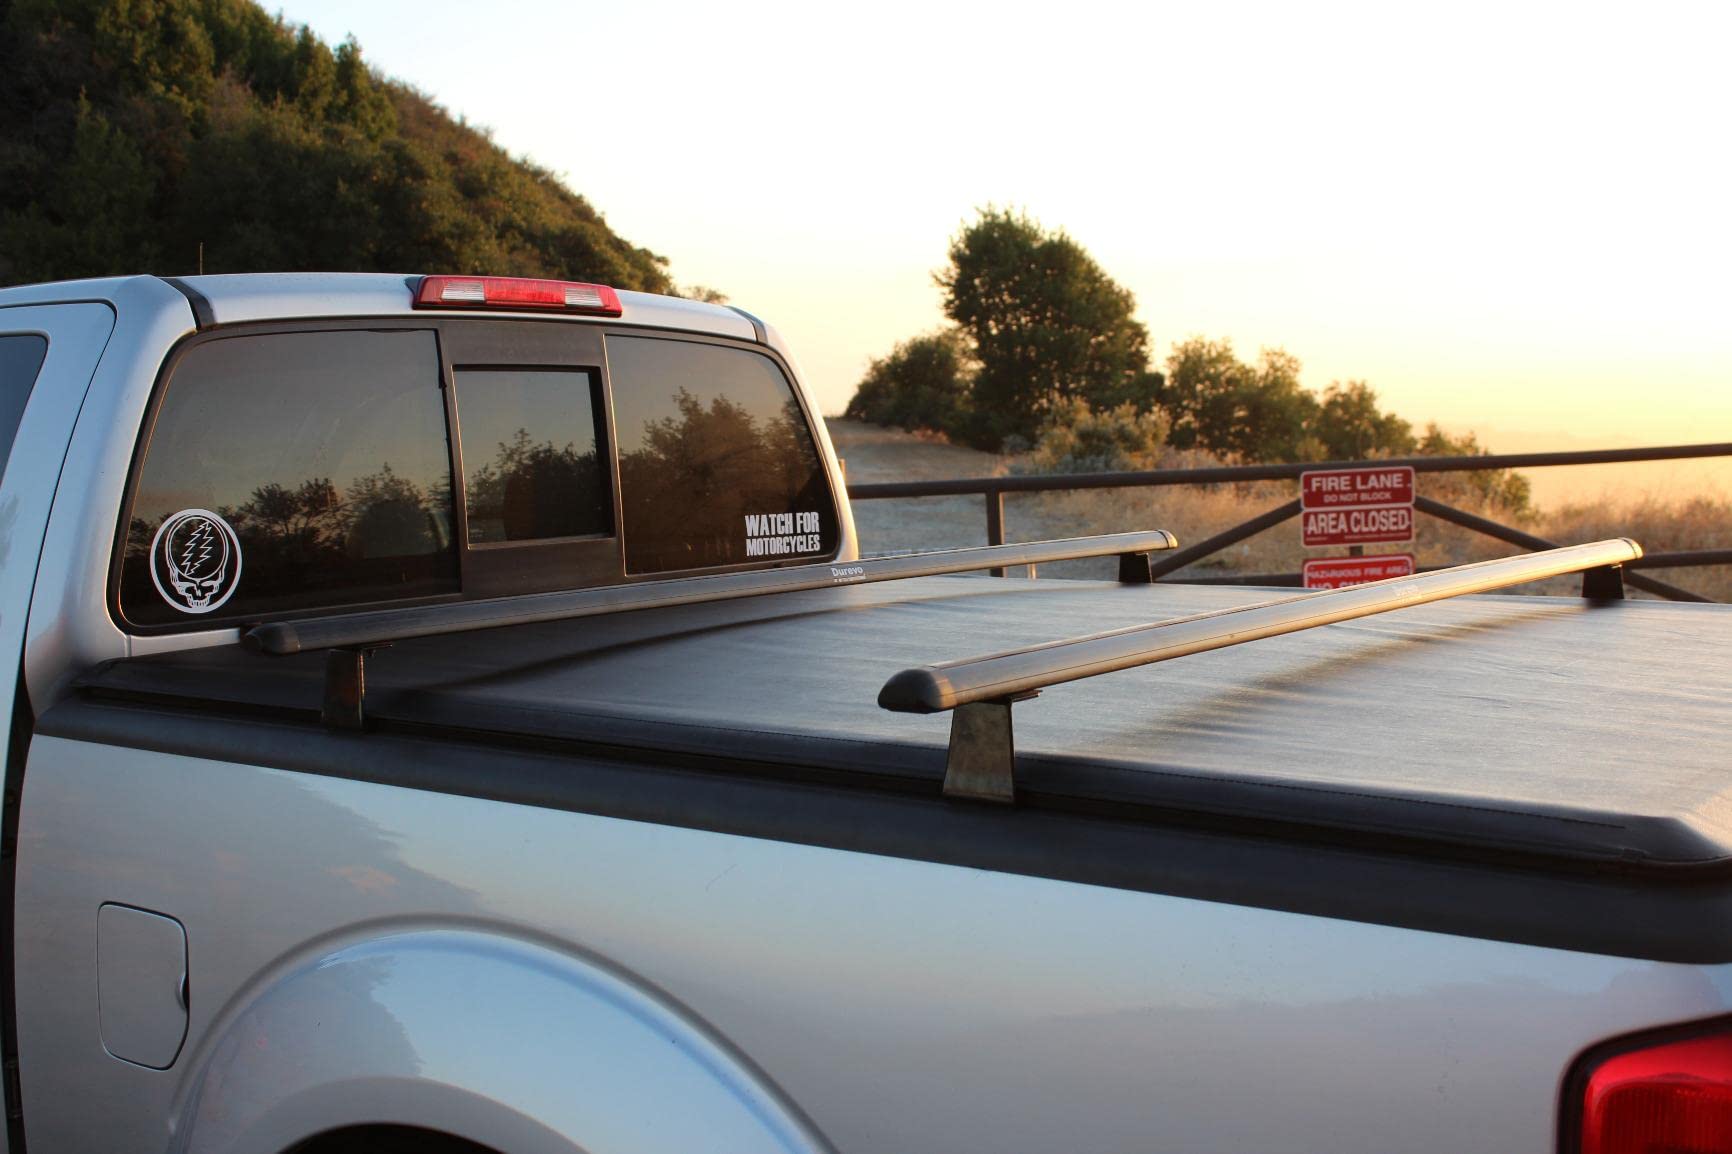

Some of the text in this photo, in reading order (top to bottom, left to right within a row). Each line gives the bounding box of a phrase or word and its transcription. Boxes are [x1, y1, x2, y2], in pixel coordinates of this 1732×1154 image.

[1311, 473, 1403, 492] FIRE LANE
[1324, 491, 1391, 503] DO NOT BLOCK
[745, 511, 820, 537] WATCH FOR
[1307, 509, 1409, 535] AREA CLOSED
[746, 534, 821, 557] MOTORCYCLES
